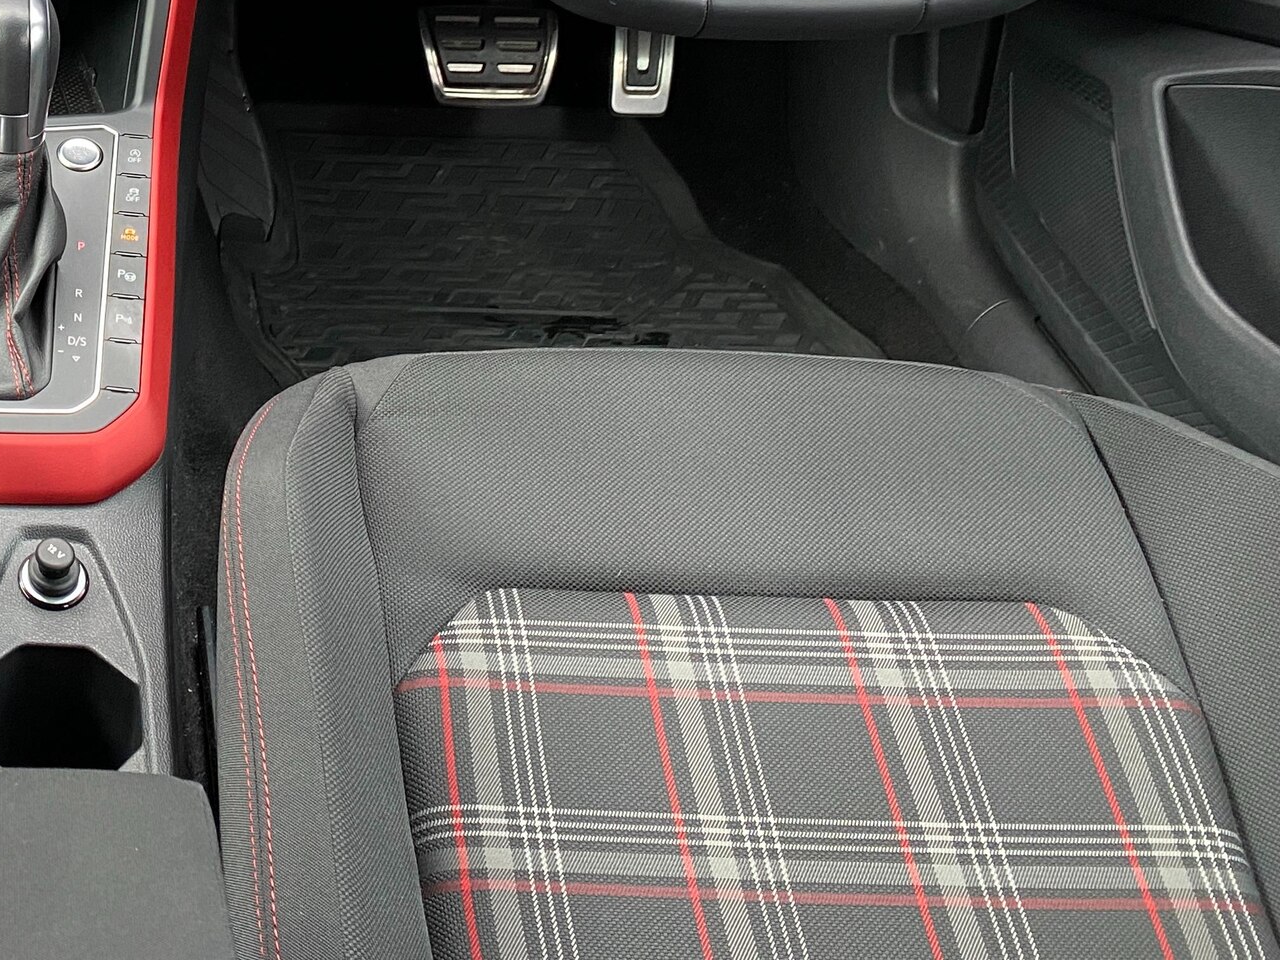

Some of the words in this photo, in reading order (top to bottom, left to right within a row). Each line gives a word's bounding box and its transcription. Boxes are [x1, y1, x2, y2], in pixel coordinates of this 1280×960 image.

[125, 194, 140, 202] OFF
[77, 241, 86, 251] P
[75, 288, 83, 298] R
[73, 313, 83, 323] N
[67, 335, 87, 347] D/S
